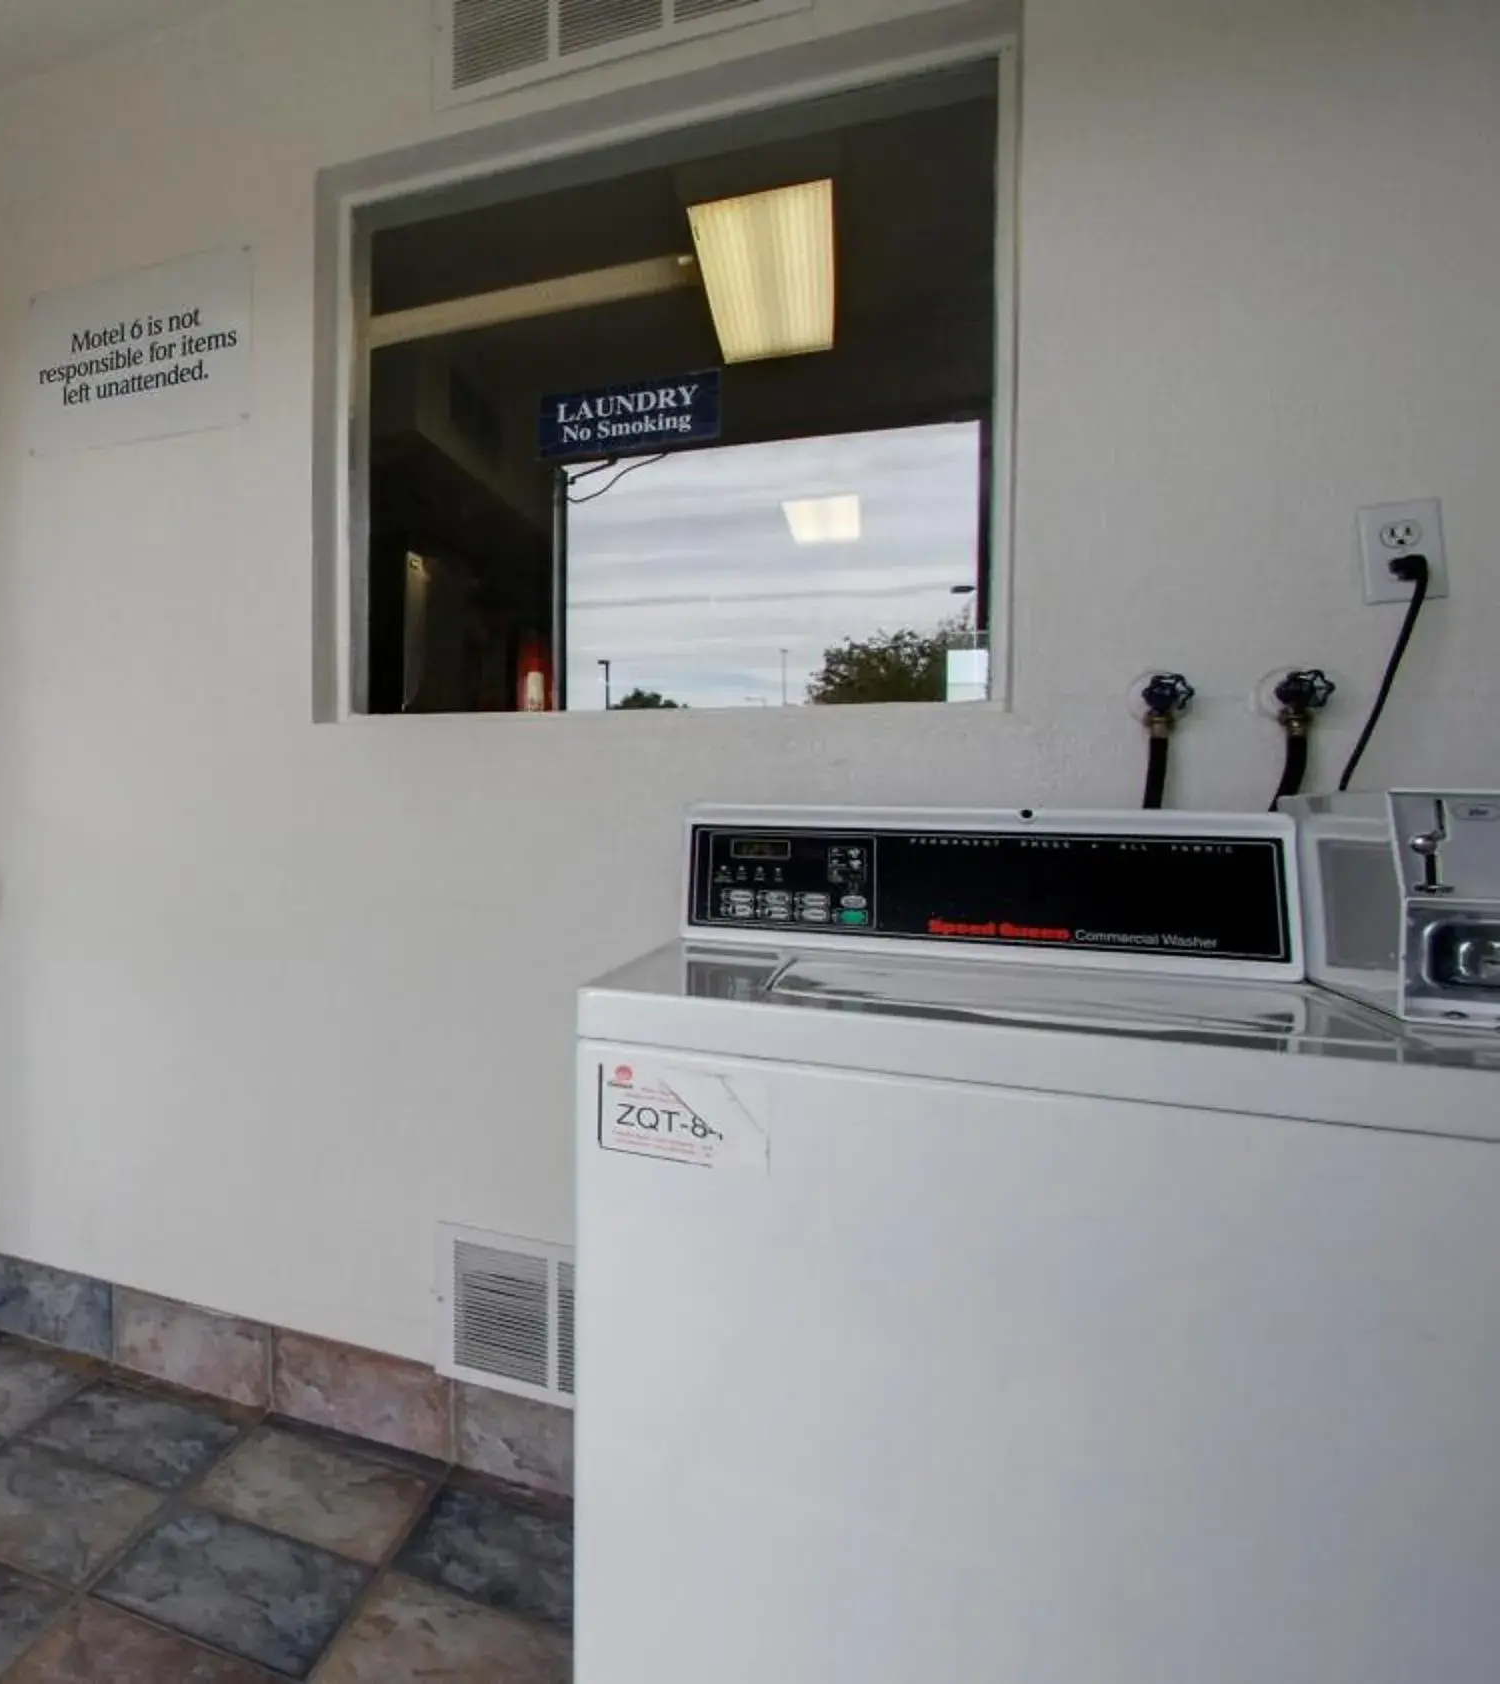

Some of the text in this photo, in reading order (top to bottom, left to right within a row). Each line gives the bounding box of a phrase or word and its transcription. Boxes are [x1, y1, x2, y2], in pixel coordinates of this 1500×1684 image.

[71, 307, 202, 353] Motel 6 is not
[38, 329, 238, 385] responsible for items
[62, 359, 209, 406] left unattended.
[556, 384, 699, 423] LAUNDRY
[562, 413, 692, 443] No Smoking
[928, 917, 997, 936] Speed
[1075, 928, 1218, 949] Commercial Washer
